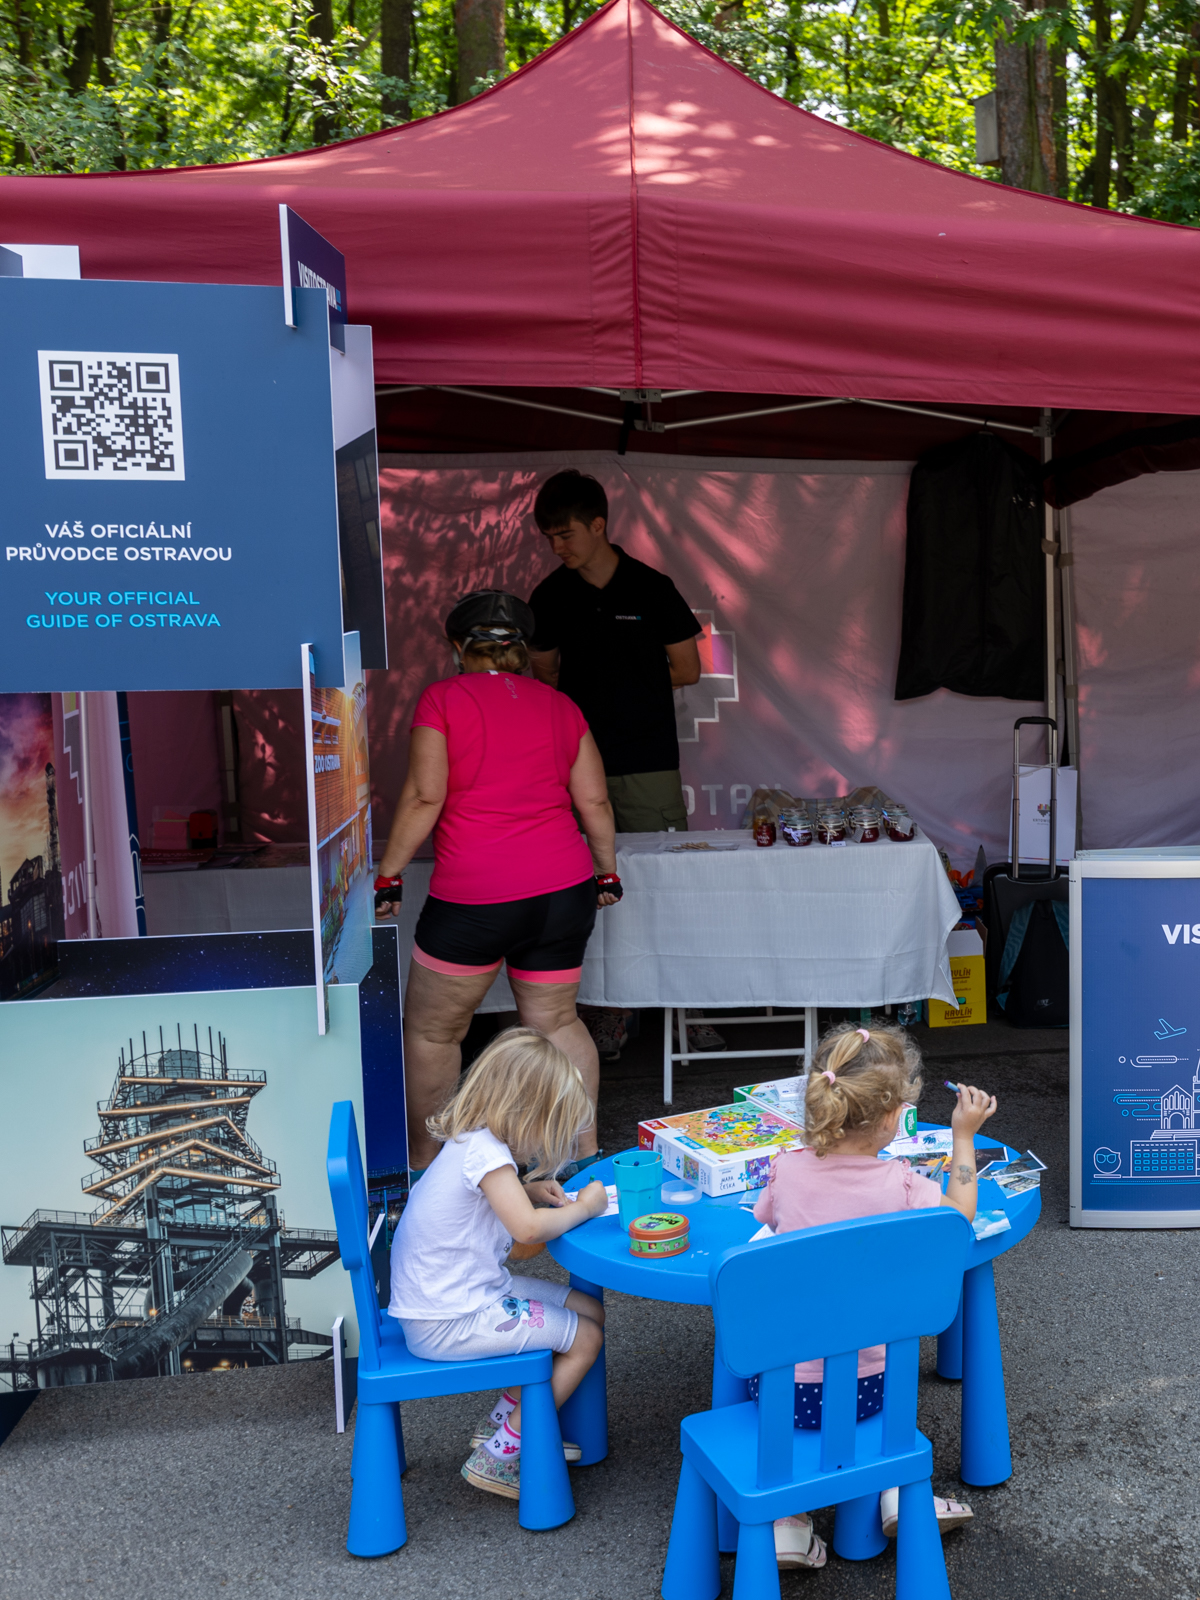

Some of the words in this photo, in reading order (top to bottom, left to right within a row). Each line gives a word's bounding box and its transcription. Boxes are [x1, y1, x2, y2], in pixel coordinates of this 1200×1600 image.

[45, 522, 84, 538] VÁŠ
[90, 522, 192, 538] OFICIÁLNÍ
[6, 543, 118, 561] PRŮVODCE
[124, 546, 232, 561] OSTRAVOU
[45, 591, 102, 606] YOUR
[108, 591, 200, 606] OFFICIAL
[26, 614, 89, 628] GUIDE
[95, 614, 123, 628] OF
[129, 614, 221, 628] OSTRAVA
[314, 755, 324, 774] ZOO
